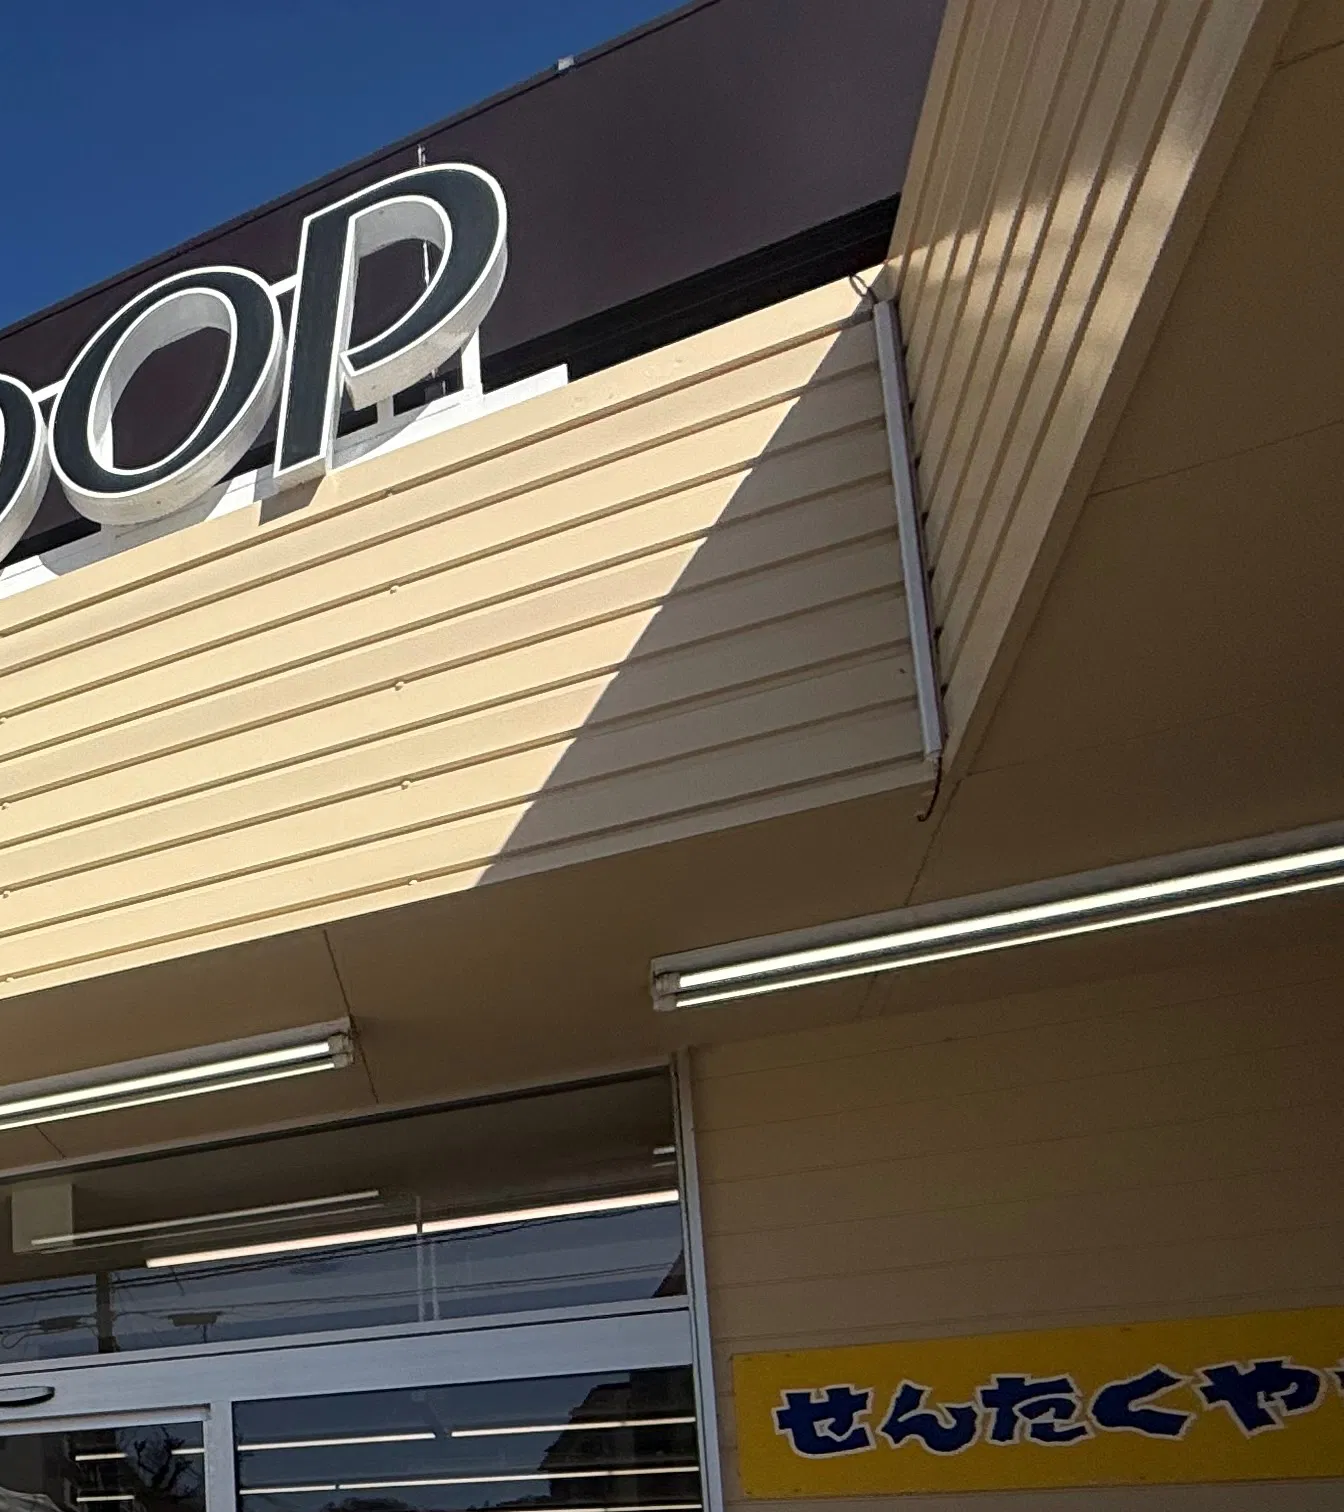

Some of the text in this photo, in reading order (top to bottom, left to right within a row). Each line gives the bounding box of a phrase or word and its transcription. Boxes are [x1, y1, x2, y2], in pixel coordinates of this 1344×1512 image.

[772, 1355, 1344, 1459] せんたくや
